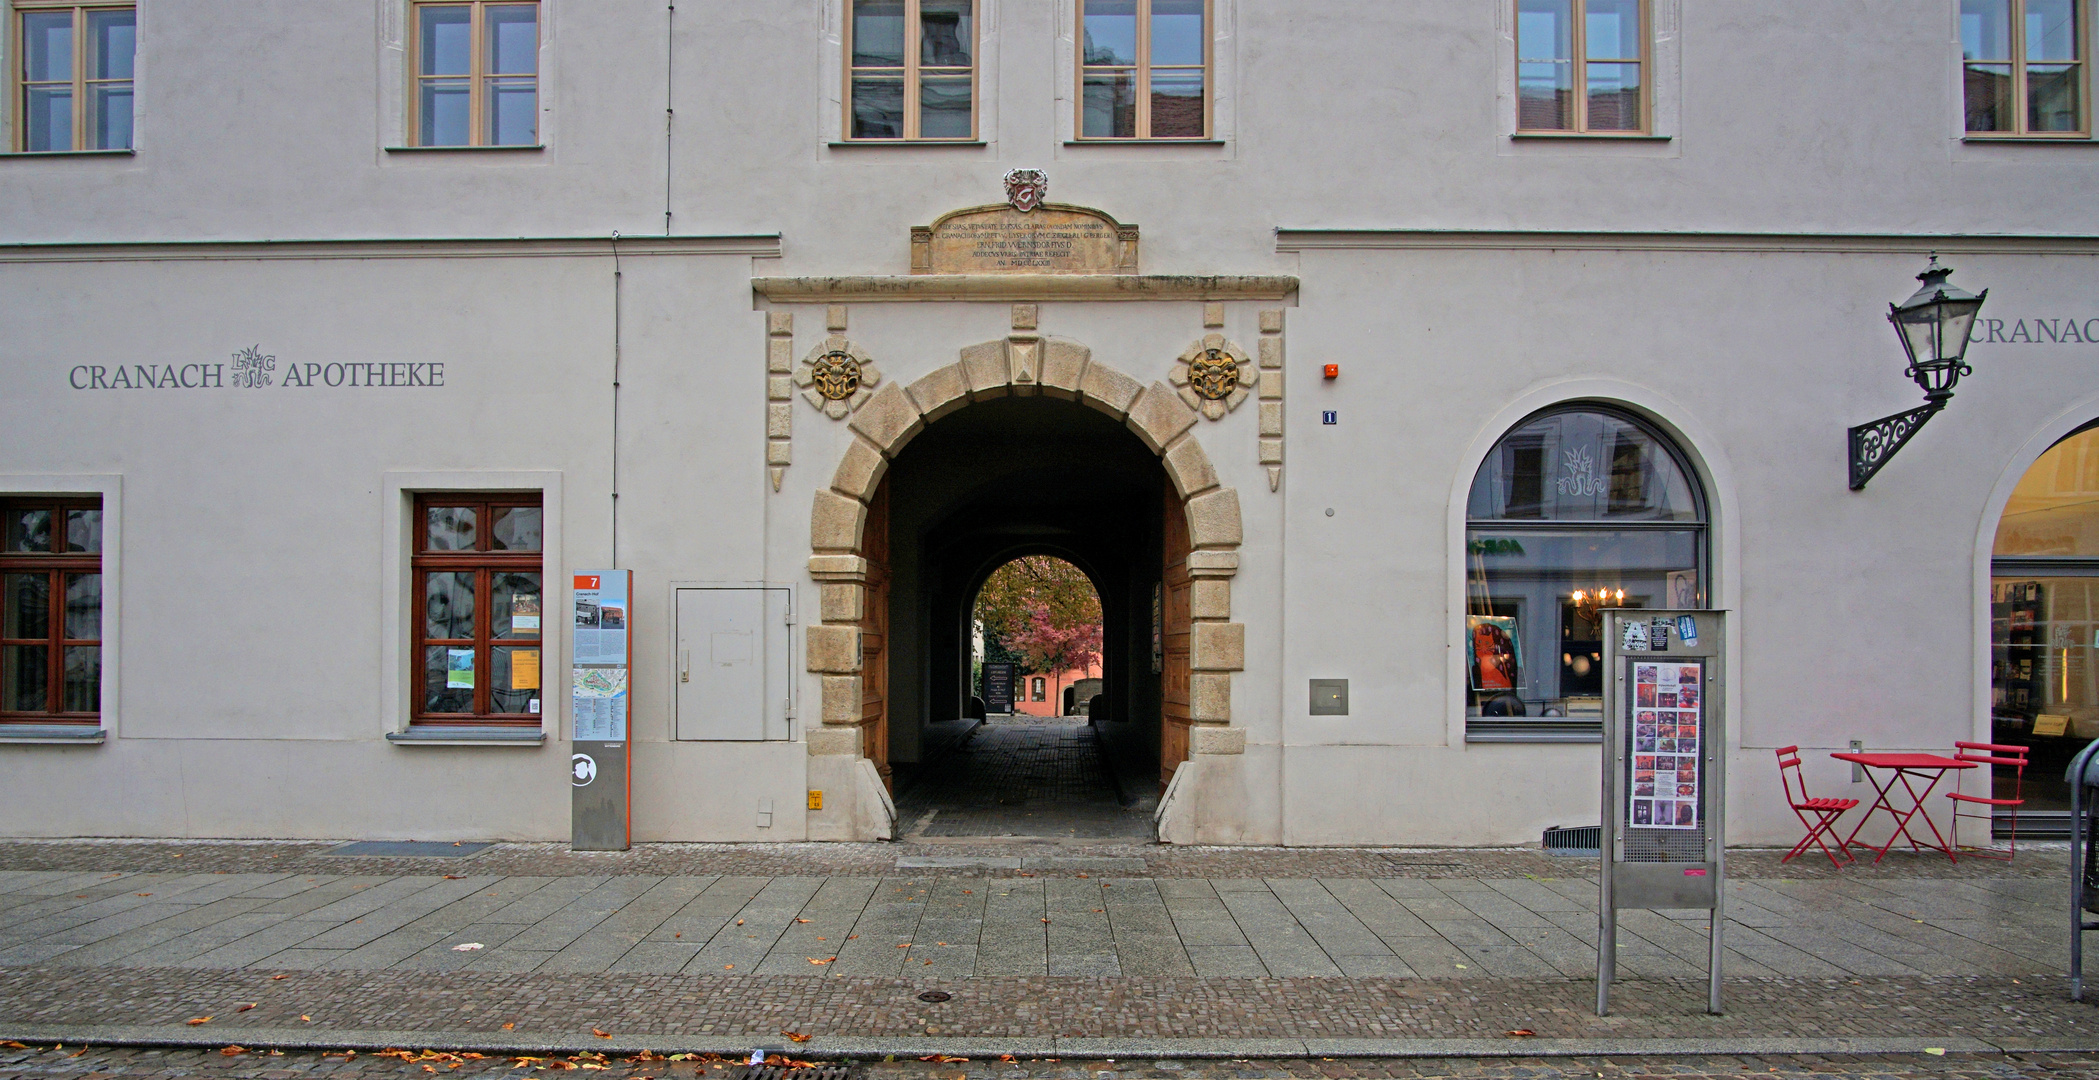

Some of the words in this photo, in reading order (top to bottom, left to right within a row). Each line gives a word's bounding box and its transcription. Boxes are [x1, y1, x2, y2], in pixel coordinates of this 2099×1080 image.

[69, 363, 224, 390] CRANACH
[282, 361, 445, 387] APOTHEKE
[591, 578, 598, 588] 7
